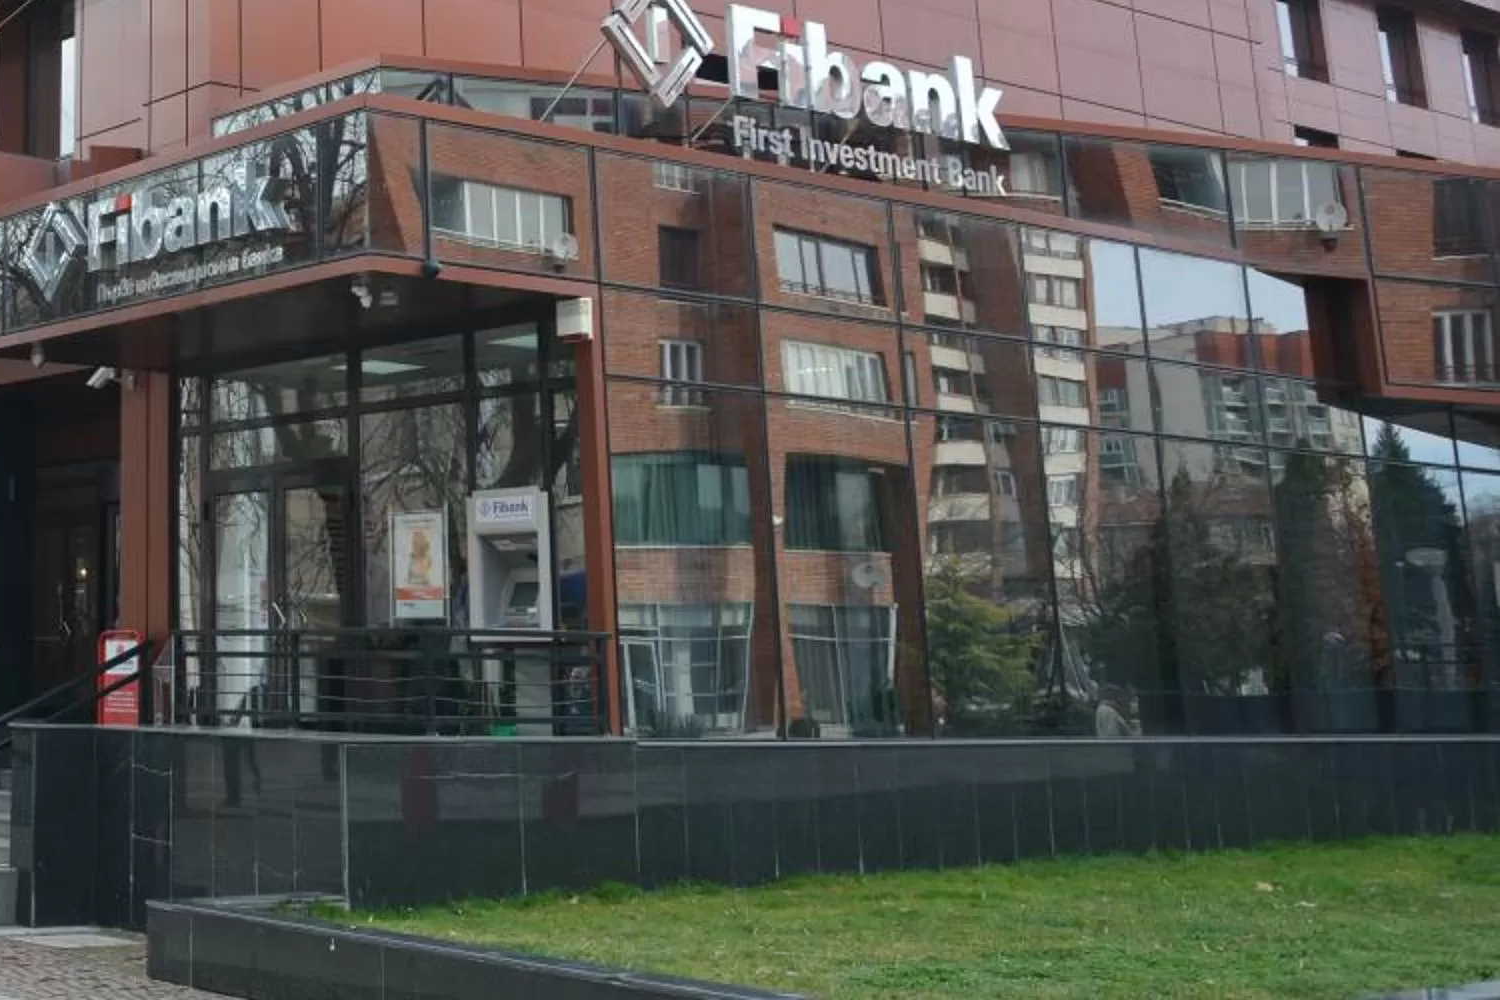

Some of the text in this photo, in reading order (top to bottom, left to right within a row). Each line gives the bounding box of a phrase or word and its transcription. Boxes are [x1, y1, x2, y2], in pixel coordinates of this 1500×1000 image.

[725, 3, 1011, 151] Fibank
[732, 115, 1007, 197] First Investment Bank
[87, 160, 296, 272] Fibank
